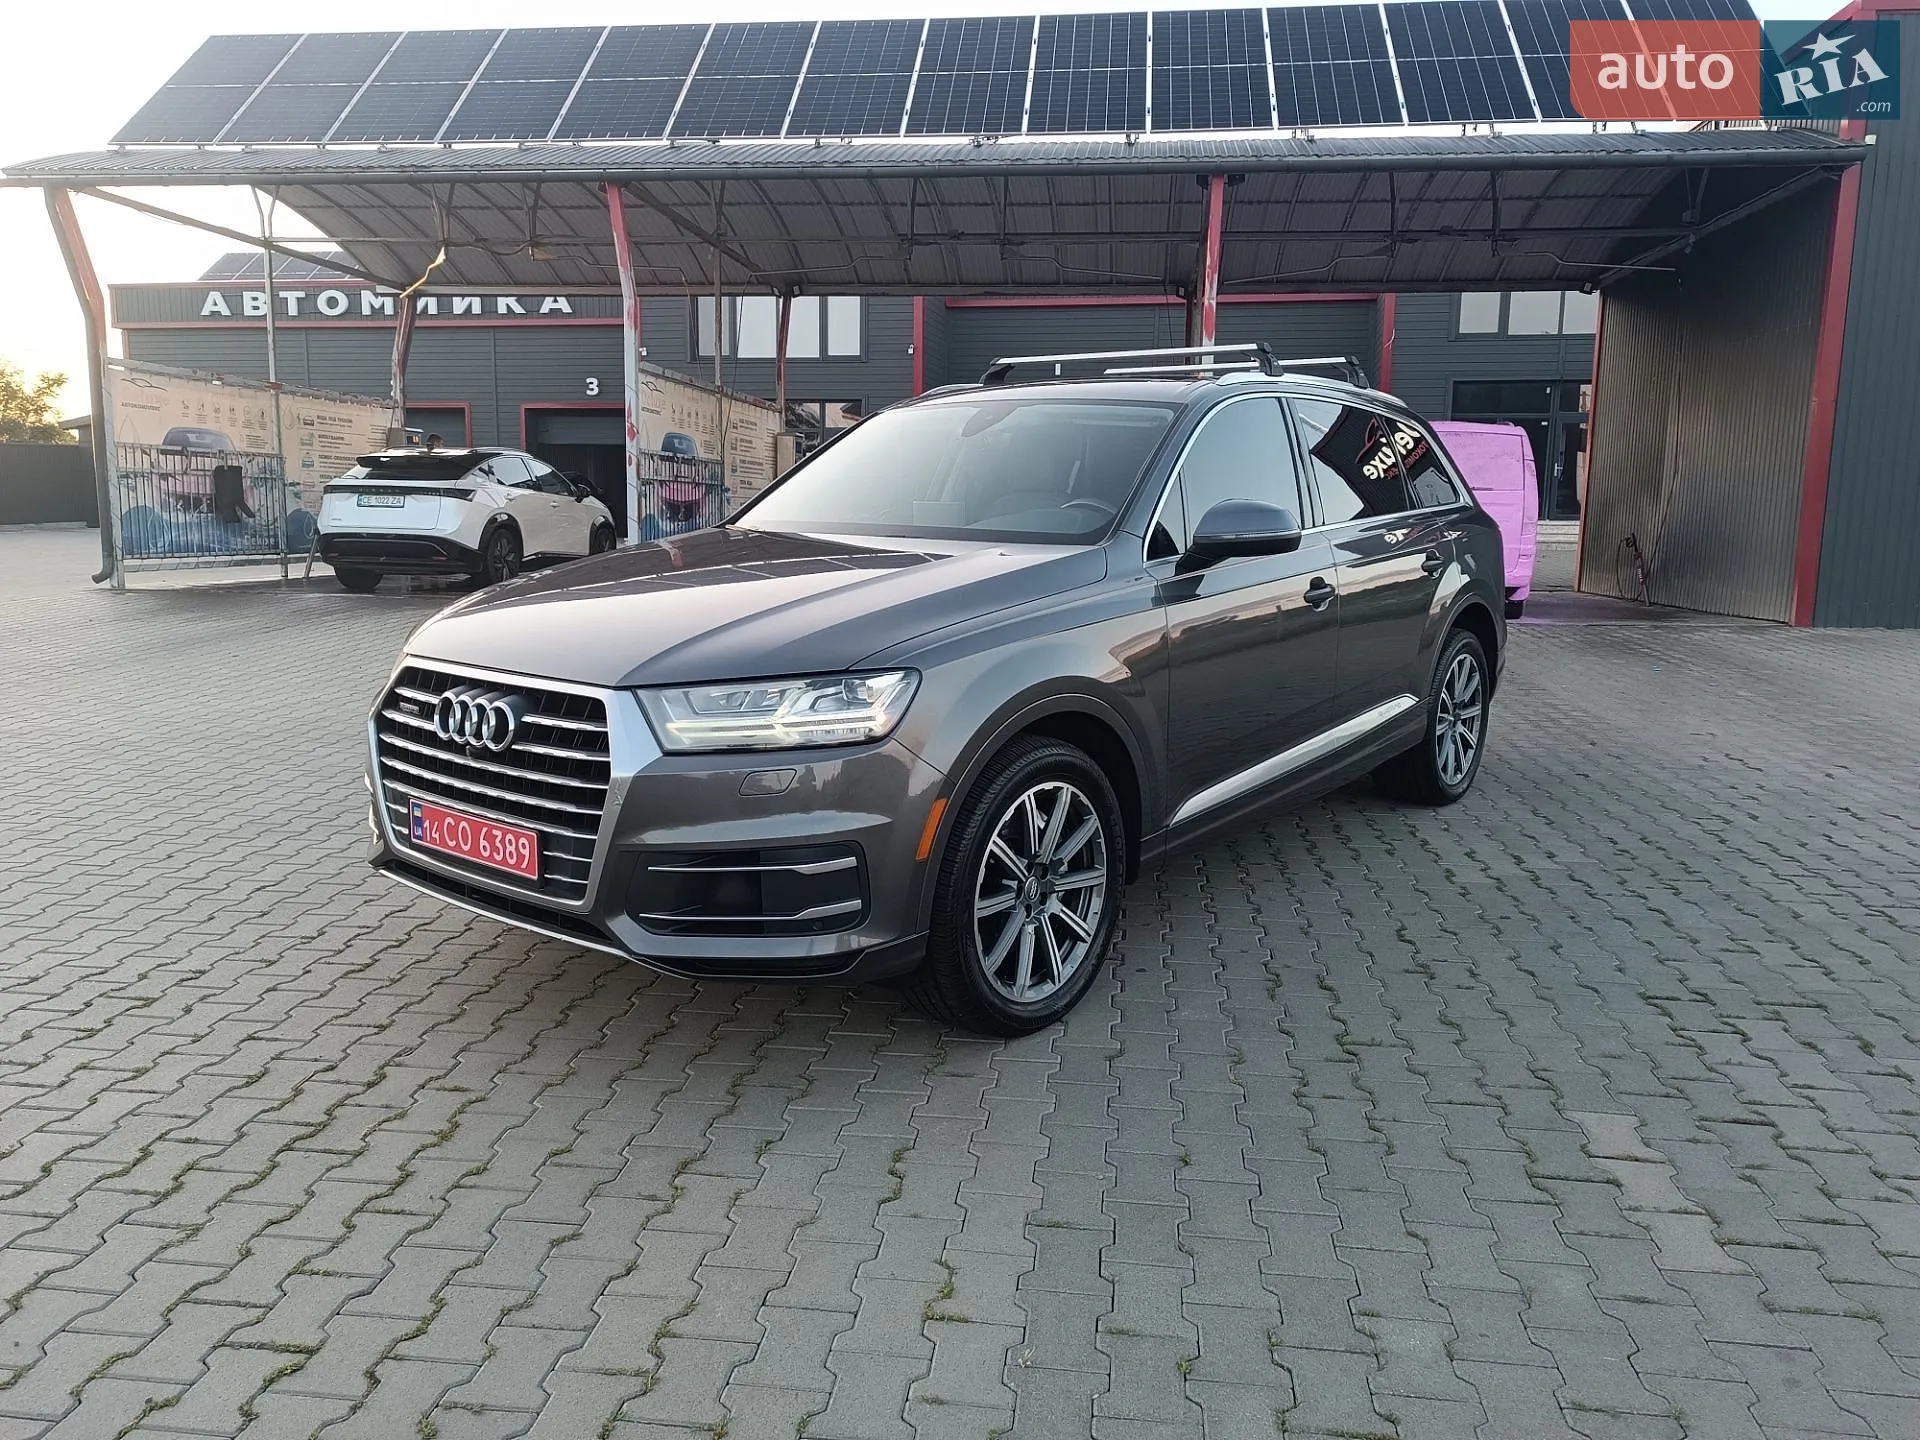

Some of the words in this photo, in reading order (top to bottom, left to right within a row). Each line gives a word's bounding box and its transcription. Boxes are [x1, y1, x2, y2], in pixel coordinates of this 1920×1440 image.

[585, 377, 599, 396] 3
[362, 496, 373, 504] CE
[375, 496, 390, 505] 1022
[414, 824, 423, 838] UA
[480, 826, 530, 869] 6389
